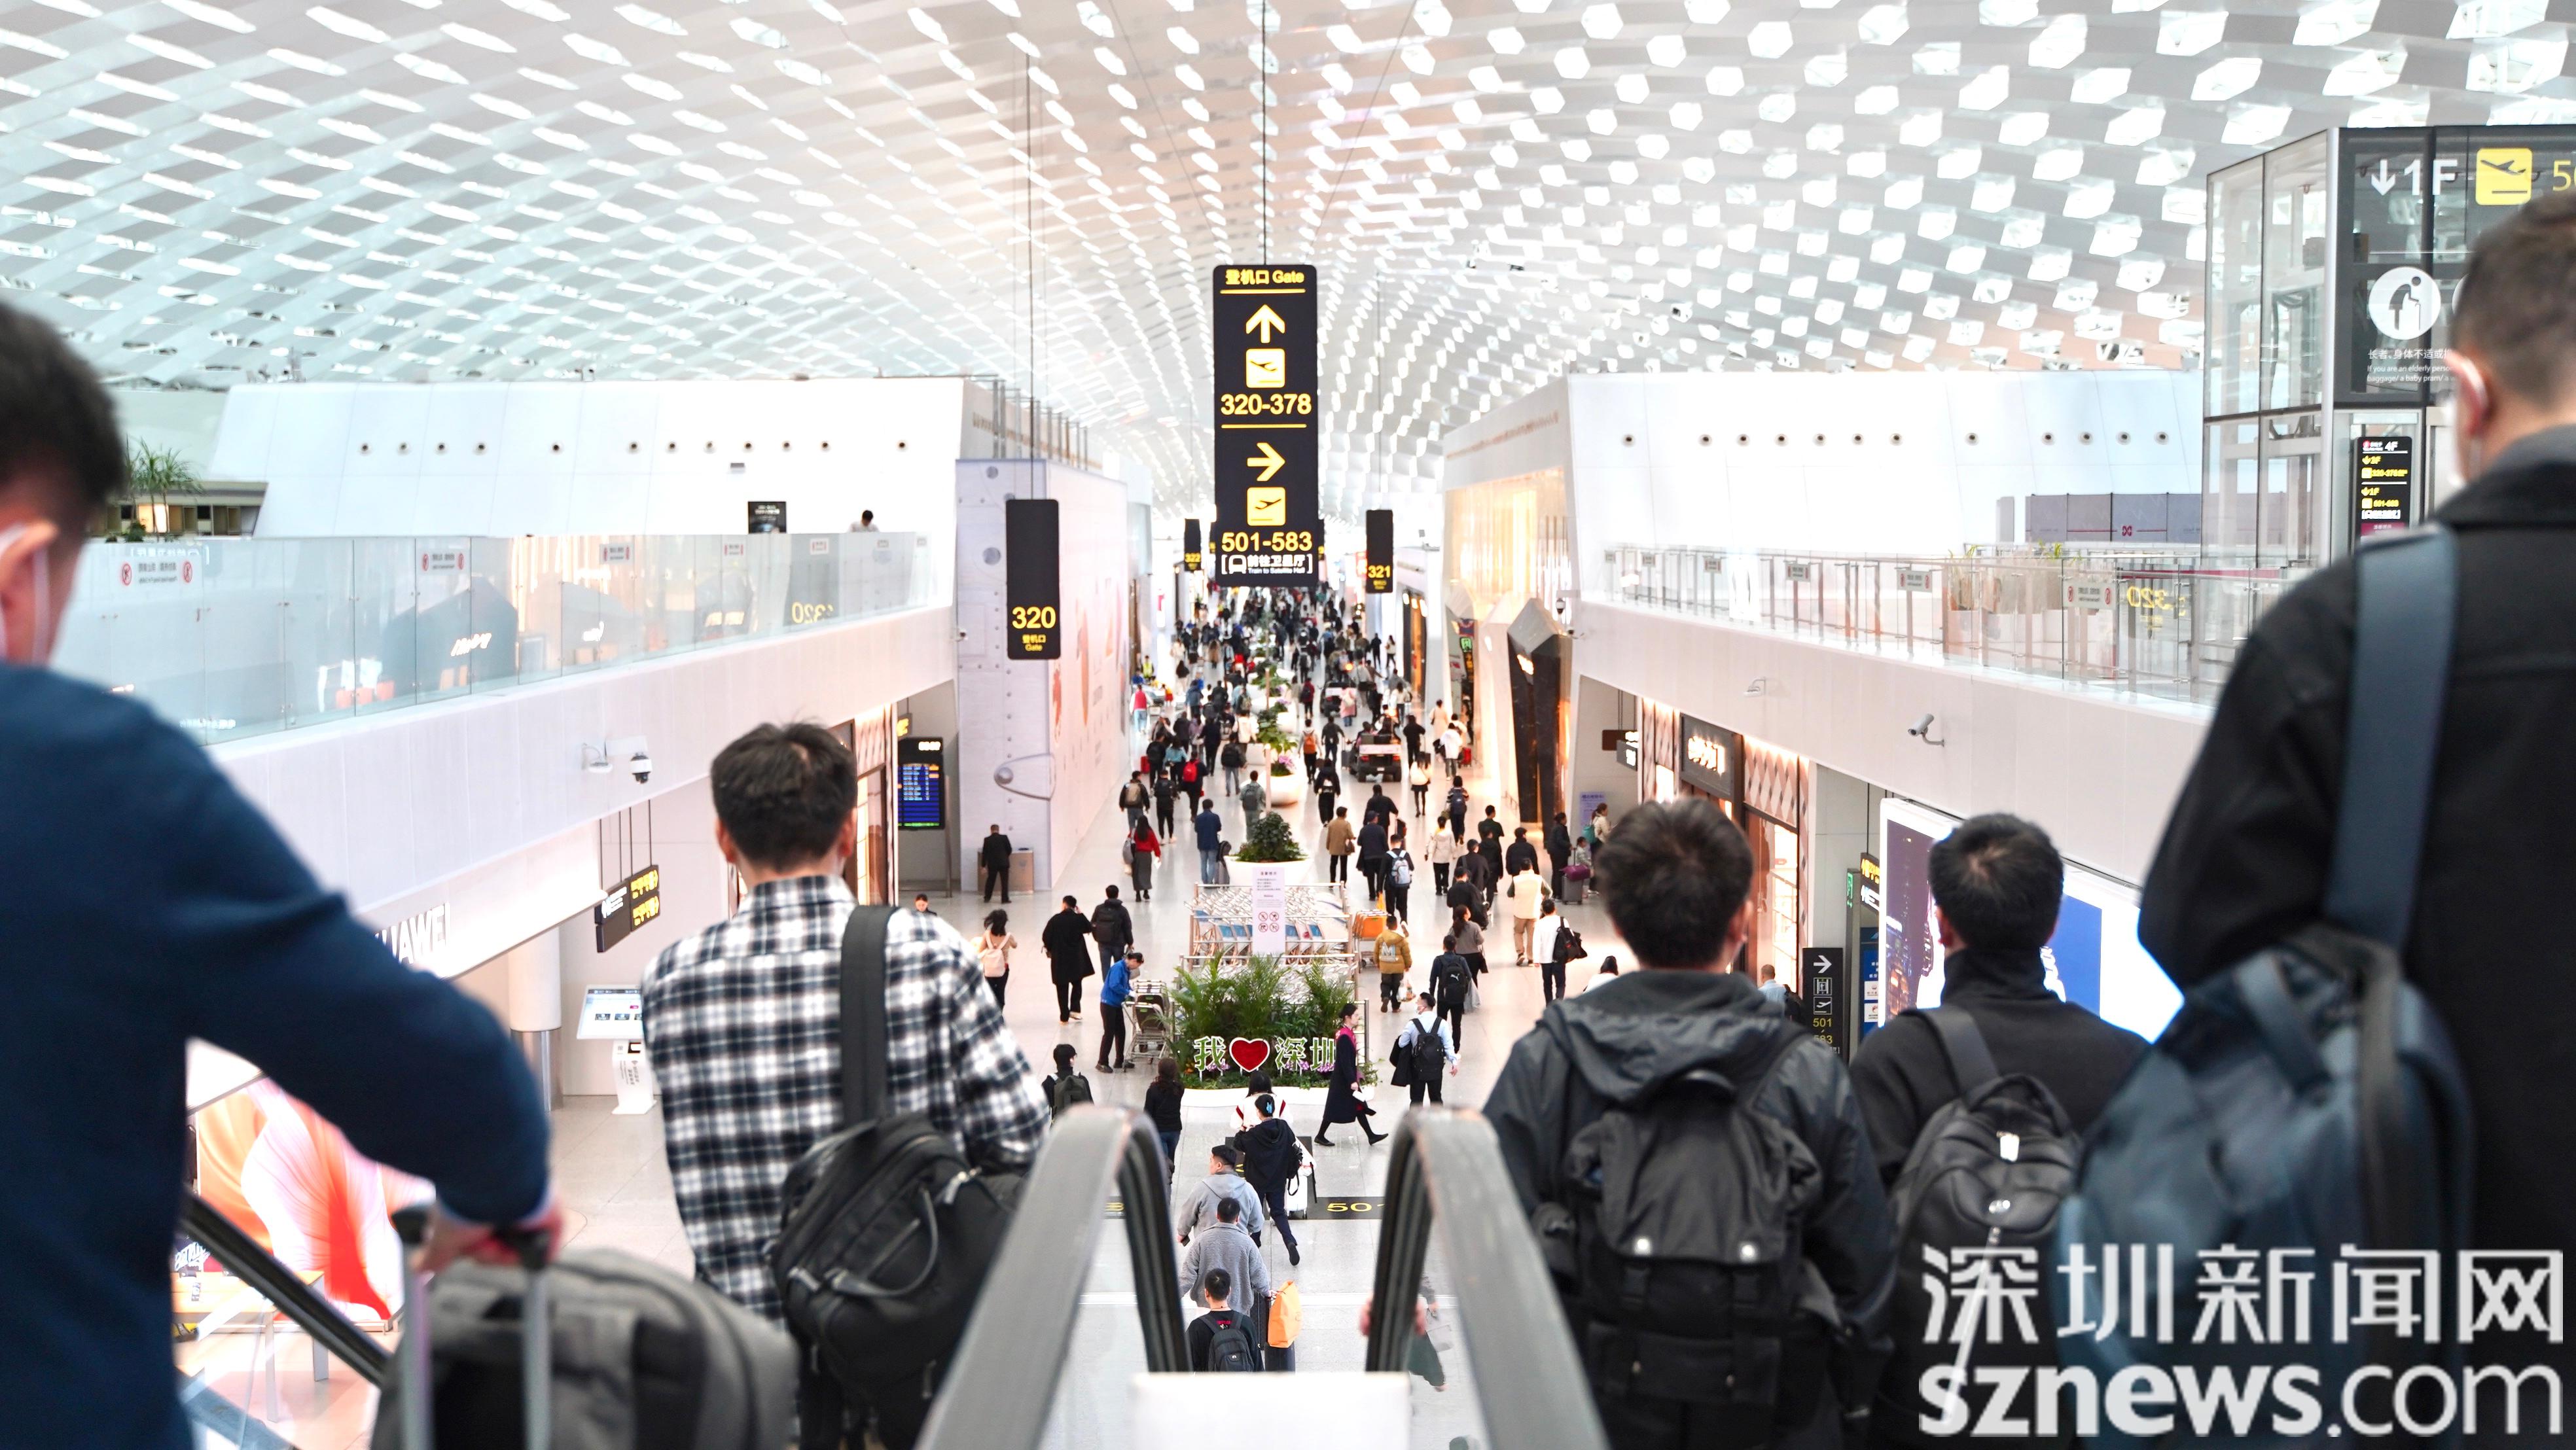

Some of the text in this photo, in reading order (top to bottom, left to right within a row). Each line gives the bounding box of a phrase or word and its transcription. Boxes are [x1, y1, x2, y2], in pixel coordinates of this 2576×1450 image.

[2404, 159, 2458, 196] 1F
[1225, 269, 1305, 285] 登机口 Gate
[2408, 364, 2431, 373] elderly
[1221, 394, 1312, 416] 320-378
[1221, 531, 1312, 552] 501-583
[1247, 554, 1306, 567] 前往卫星厅
[1368, 565, 1391, 578] 321
[1012, 606, 1056, 629] 320
[1813, 1017, 1833, 1027] 501
[1193, 1036, 1336, 1072] 我 深圳
[1327, 1203, 1384, 1212] 50
